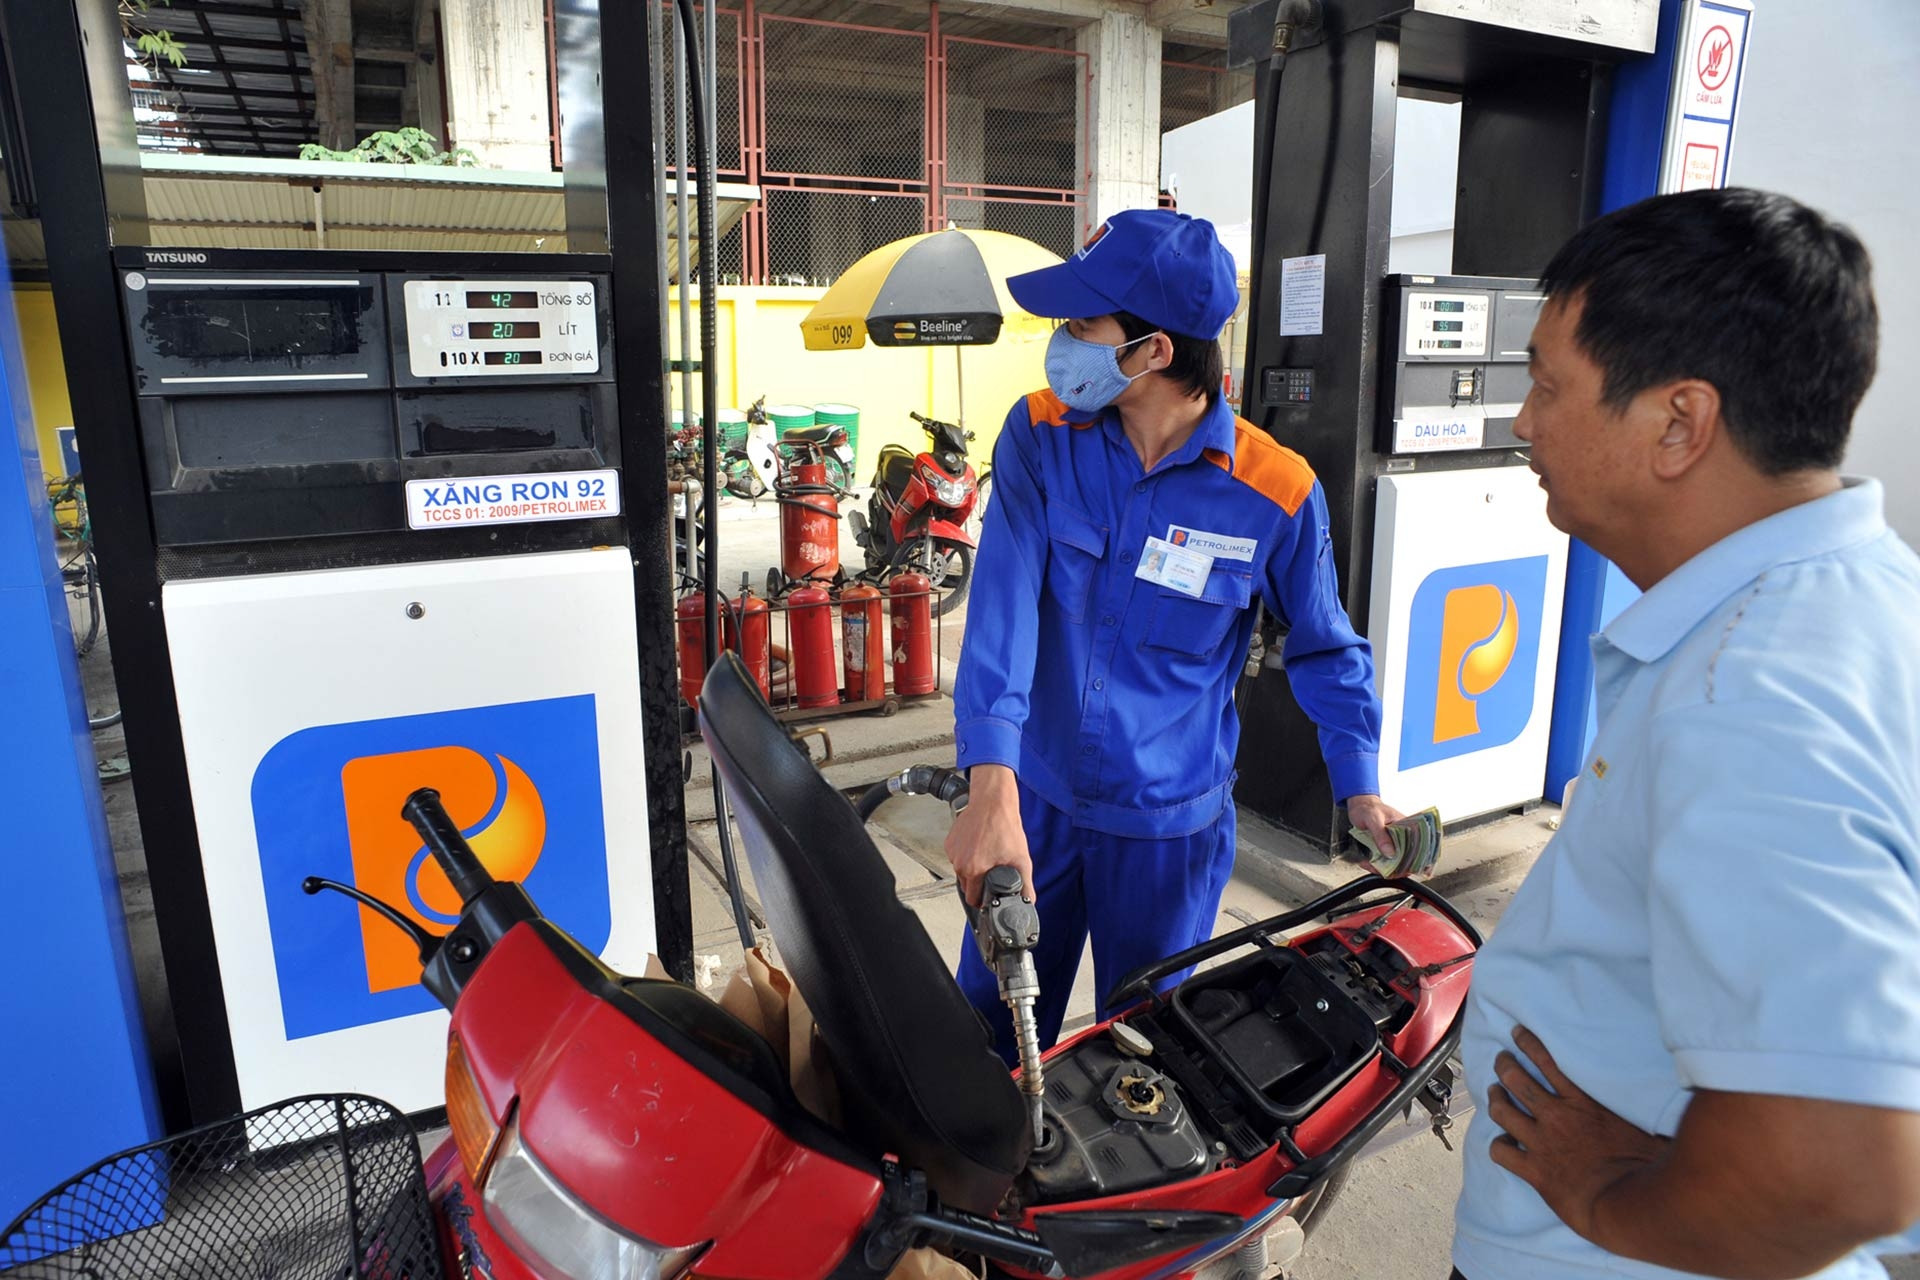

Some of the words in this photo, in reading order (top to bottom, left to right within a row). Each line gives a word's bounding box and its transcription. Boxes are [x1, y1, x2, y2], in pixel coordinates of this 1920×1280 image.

[145, 253, 207, 263] TATSUNO
[491, 293, 511, 307] 42
[540, 291, 572, 306] TỔNG
[576, 292, 592, 306] SỐ
[559, 321, 578, 336] LÍT
[832, 325, 853, 344] 099
[451, 352, 467, 365] 10
[471, 351, 480, 365] X
[504, 352, 521, 364] 20
[574, 350, 593, 361] GIÁ
[423, 482, 502, 507] XĂNG
[512, 481, 569, 501] RON
[577, 479, 605, 498] 92
[424, 508, 461, 522] TCCS
[465, 507, 485, 519] 01:
[489, 499, 607, 518] 2009/PETROLIMEX
[1189, 537, 1253, 555] PETROLIMEX
